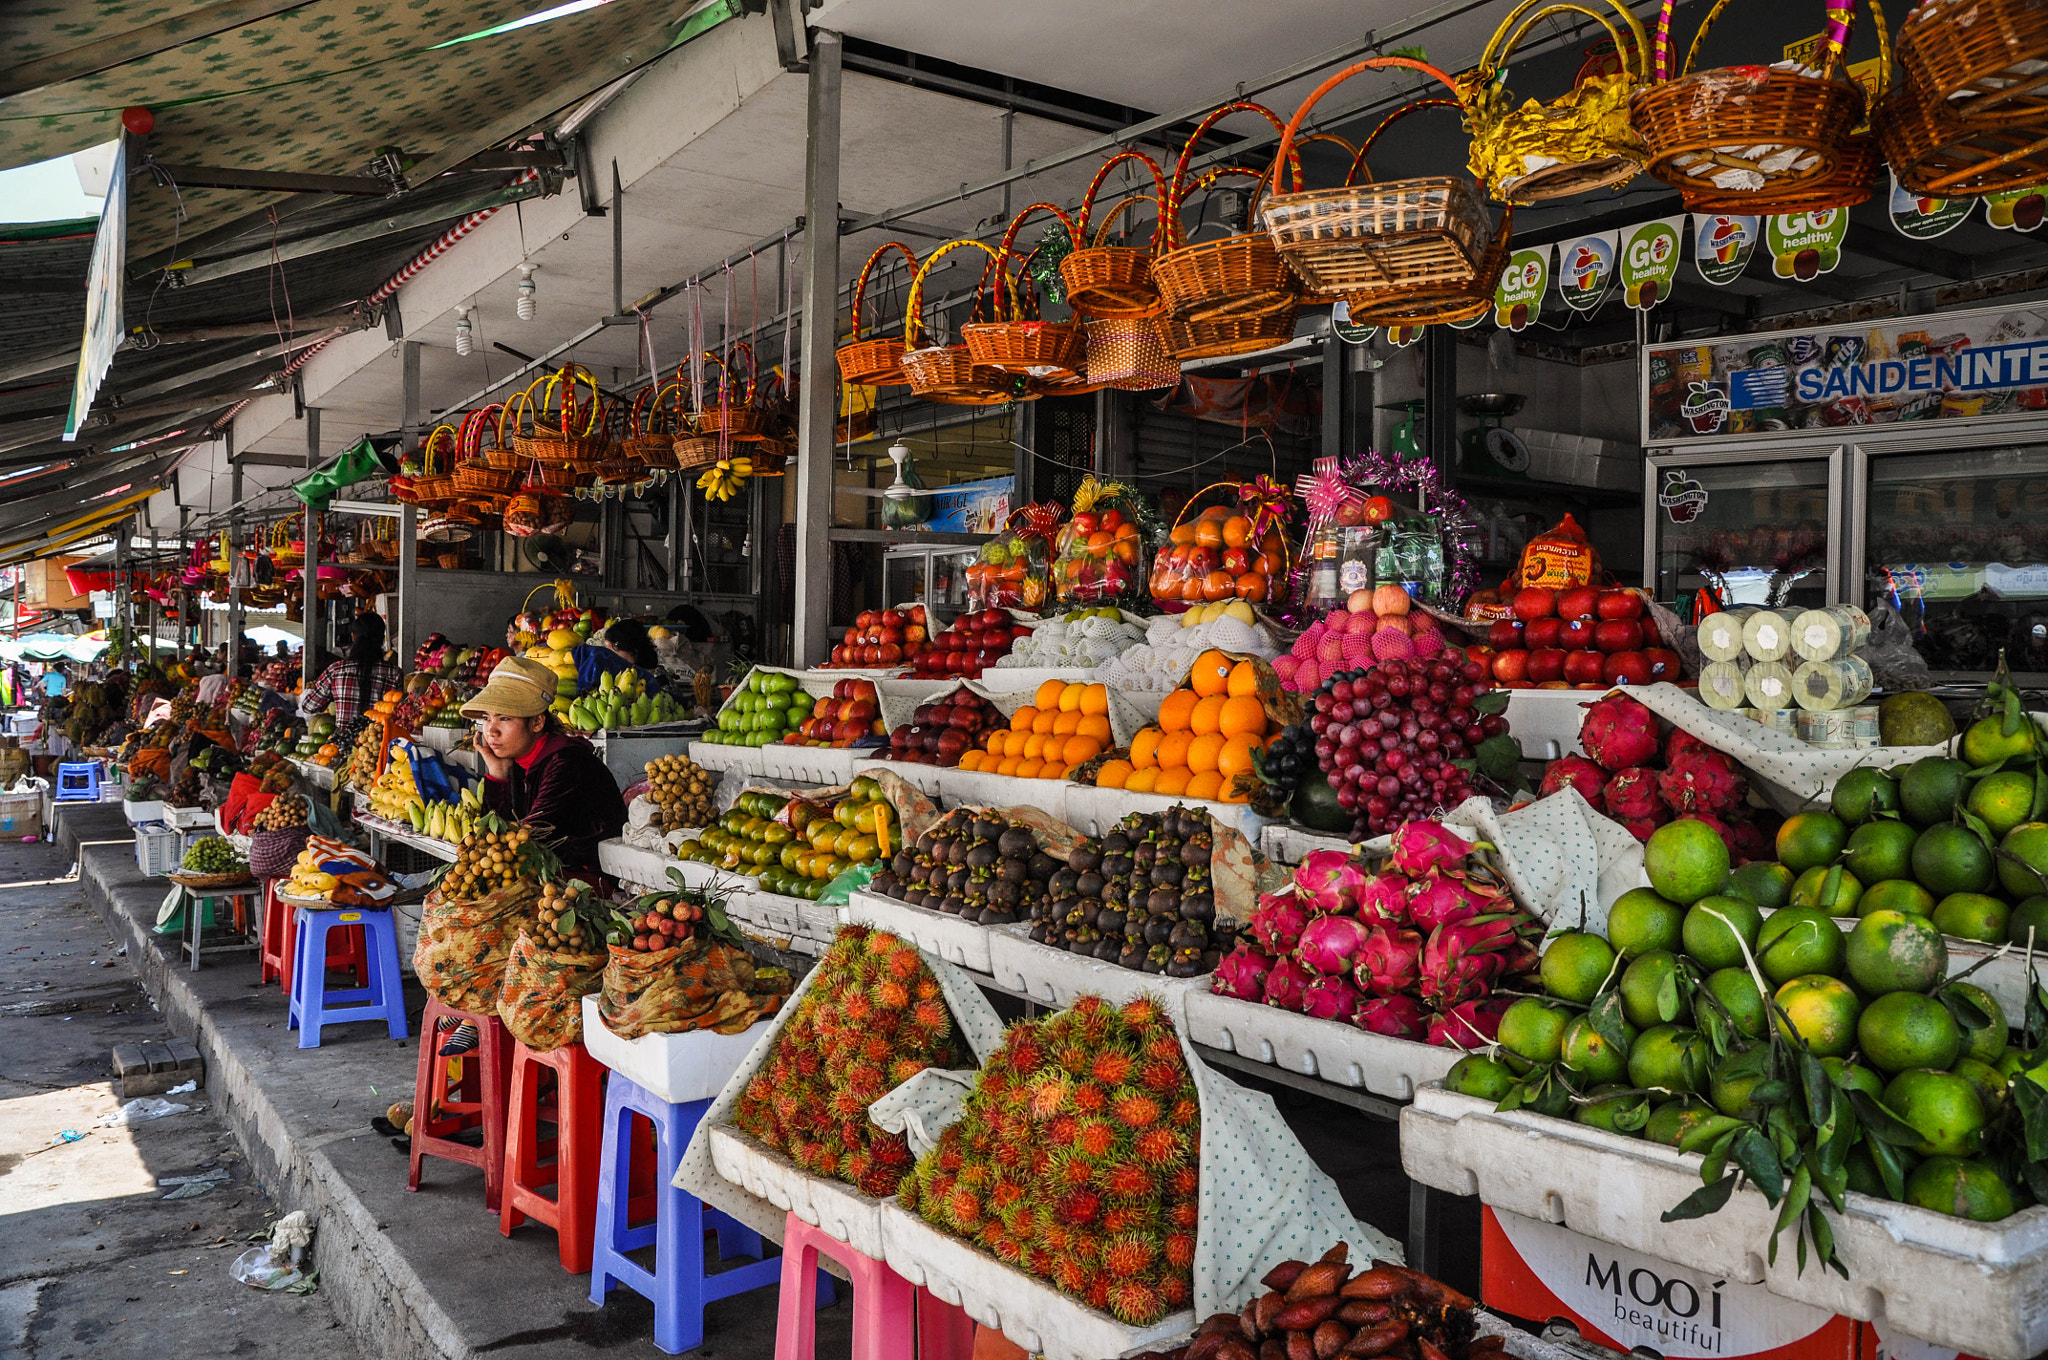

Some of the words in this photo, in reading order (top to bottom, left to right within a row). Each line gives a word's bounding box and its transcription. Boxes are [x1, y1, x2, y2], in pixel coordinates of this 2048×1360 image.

[1711, 232, 1746, 248] WASHINGTON
[1783, 231, 1834, 249] healthy.
[1629, 234, 1673, 269] GO
[1501, 260, 1542, 292] GO
[1632, 264, 1669, 280] healthy.
[1503, 289, 1538, 303] healthy.
[1683, 401, 1729, 417] WASHINGTON
[936, 493, 969, 510] MIRAGE
[1661, 491, 1706, 505] WASHINGTON
[1613, 1297, 1721, 1354] beautiful
